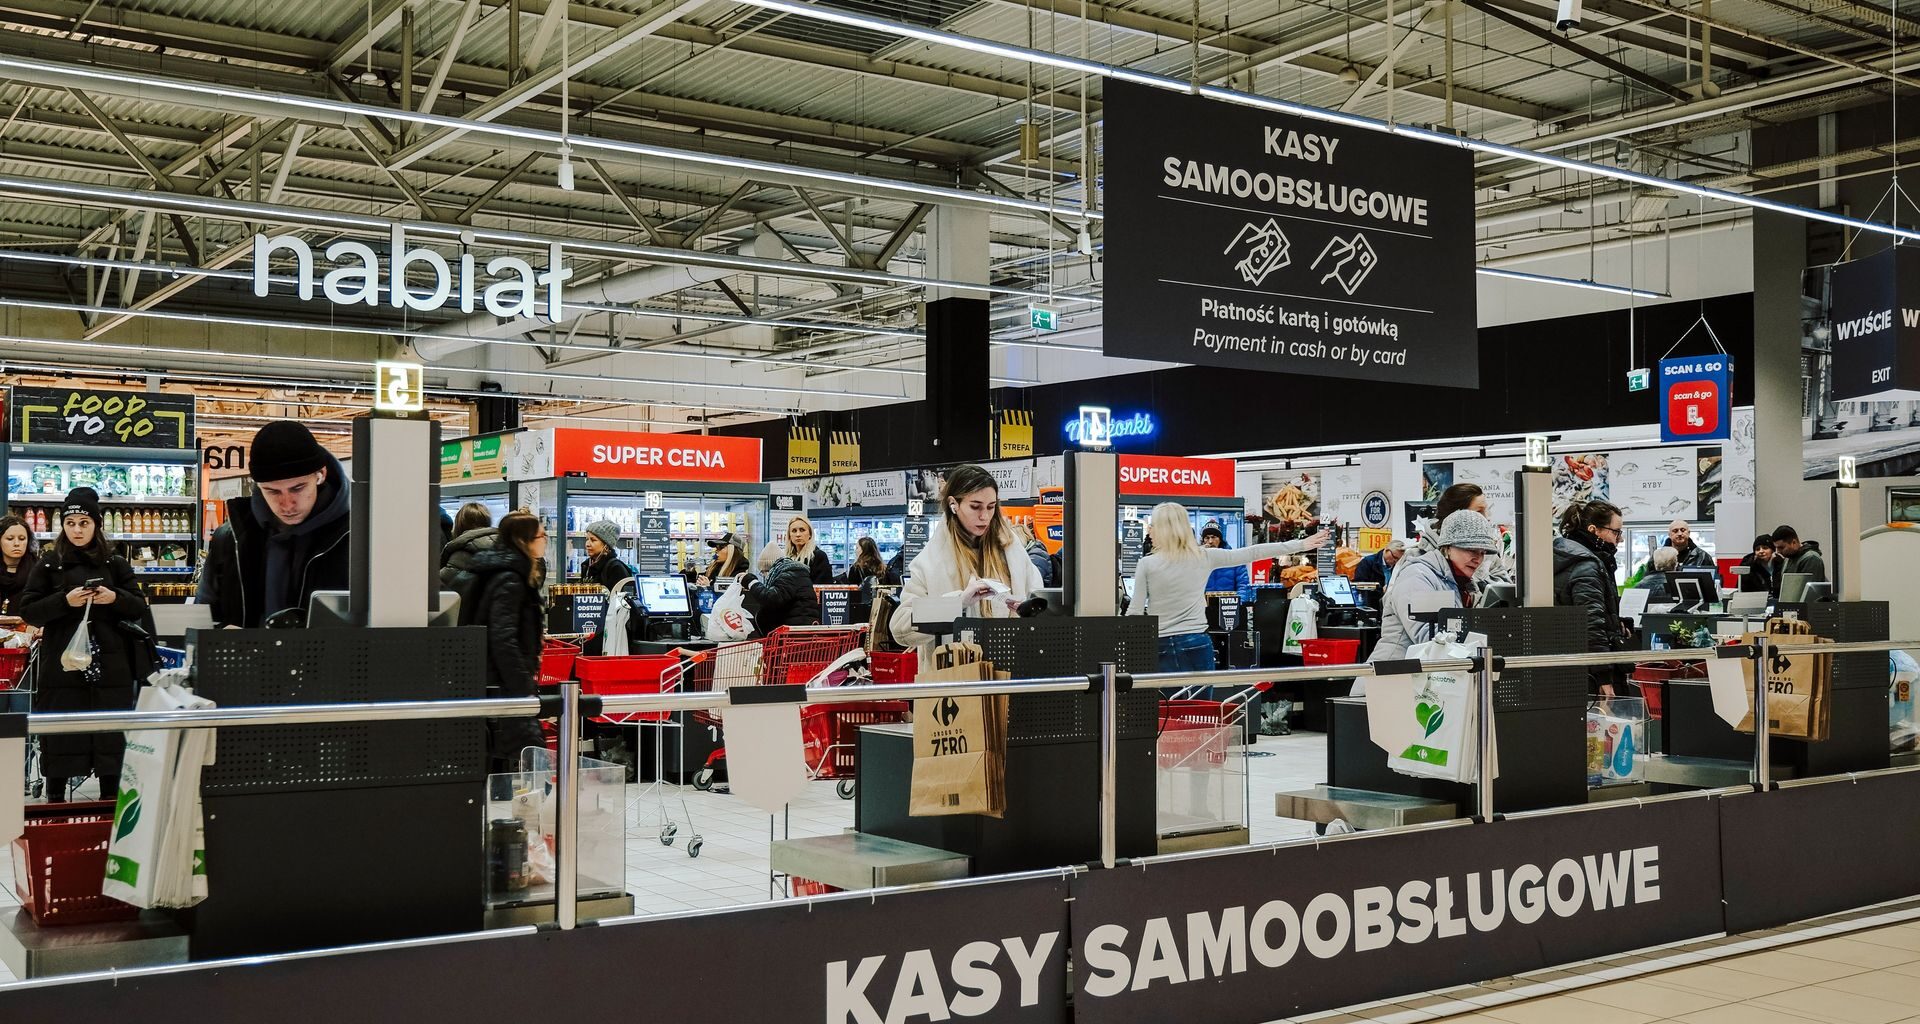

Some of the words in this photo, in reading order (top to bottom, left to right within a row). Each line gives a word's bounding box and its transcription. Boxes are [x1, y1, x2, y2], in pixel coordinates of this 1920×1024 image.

[1264, 125, 1339, 165] KASY
[1163, 156, 1428, 226] SAMOOBSŁUGOWE
[254, 223, 573, 323] nabiał
[1201, 298, 1275, 325] Płatność
[1279, 307, 1320, 333] kartą
[1324, 311, 1329, 330] i
[1333, 315, 1399, 341] gotówką
[1836, 309, 1892, 341] WYJŚCIE
[1901, 308, 1920, 328] W
[1193, 328, 1267, 354] Payment
[1270, 336, 1285, 355] in
[1289, 341, 1327, 359] cash
[1330, 345, 1348, 360] or
[1350, 344, 1370, 367] by
[1372, 349, 1407, 366] card
[1664, 364, 1693, 376] SCAN
[1695, 363, 1703, 373] &
[1704, 362, 1722, 372] GO
[1871, 366, 1891, 384] EXIT
[62, 392, 147, 416] FOOD
[1673, 392, 1693, 400] scan
[1693, 391, 1701, 399] &
[1700, 391, 1712, 400] go
[65, 413, 105, 435] TO
[114, 417, 154, 443] GO
[1065, 412, 1154, 442] Możonki
[592, 444, 663, 466] SUPER
[667, 448, 726, 469] CENA
[1003, 443, 1030, 451] STREFA
[790, 456, 817, 464] STREFA
[1120, 466, 1169, 484] SUPER
[1171, 468, 1211, 485] CENA
[1642, 481, 1663, 489] RYBY
[648, 493, 660, 508] 19
[910, 501, 920, 515] 20
[1126, 508, 1136, 518] 21
[1368, 513, 1383, 521] FOOD
[576, 595, 604, 603] TUTAJ
[825, 592, 848, 600] TUTAJ
[1768, 681, 1794, 695] ERO
[931, 735, 968, 757] ZERO
[826, 931, 1060, 1024] KASY
[1084, 845, 1661, 998] SAMOOBSŁUGOWE
